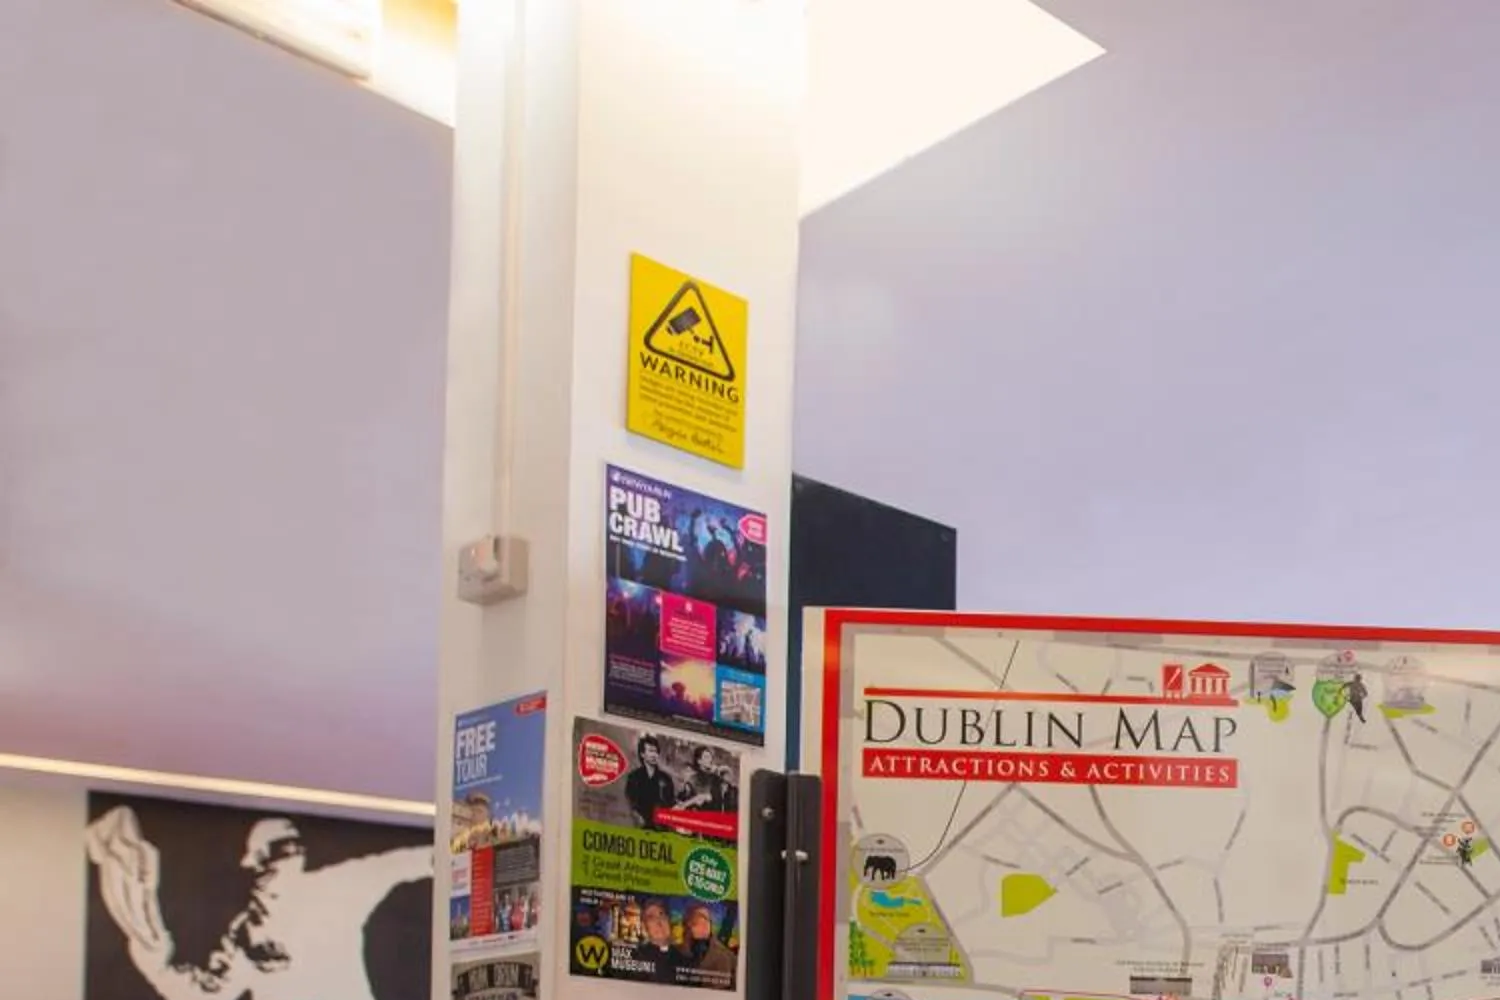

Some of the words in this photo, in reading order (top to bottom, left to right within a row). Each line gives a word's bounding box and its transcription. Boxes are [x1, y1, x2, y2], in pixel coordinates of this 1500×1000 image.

[640, 352, 739, 403] WARNING
[610, 485, 661, 523] PUB
[610, 512, 684, 553] CRAWL
[457, 720, 496, 759] FREE
[456, 753, 488, 783] TOUR
[869, 756, 1050, 778] ATTRACTIONS
[1060, 761, 1077, 778] &
[1086, 760, 1231, 783] ACTIVITIES
[583, 829, 635, 858] COMBO
[639, 839, 677, 865] DEAL
